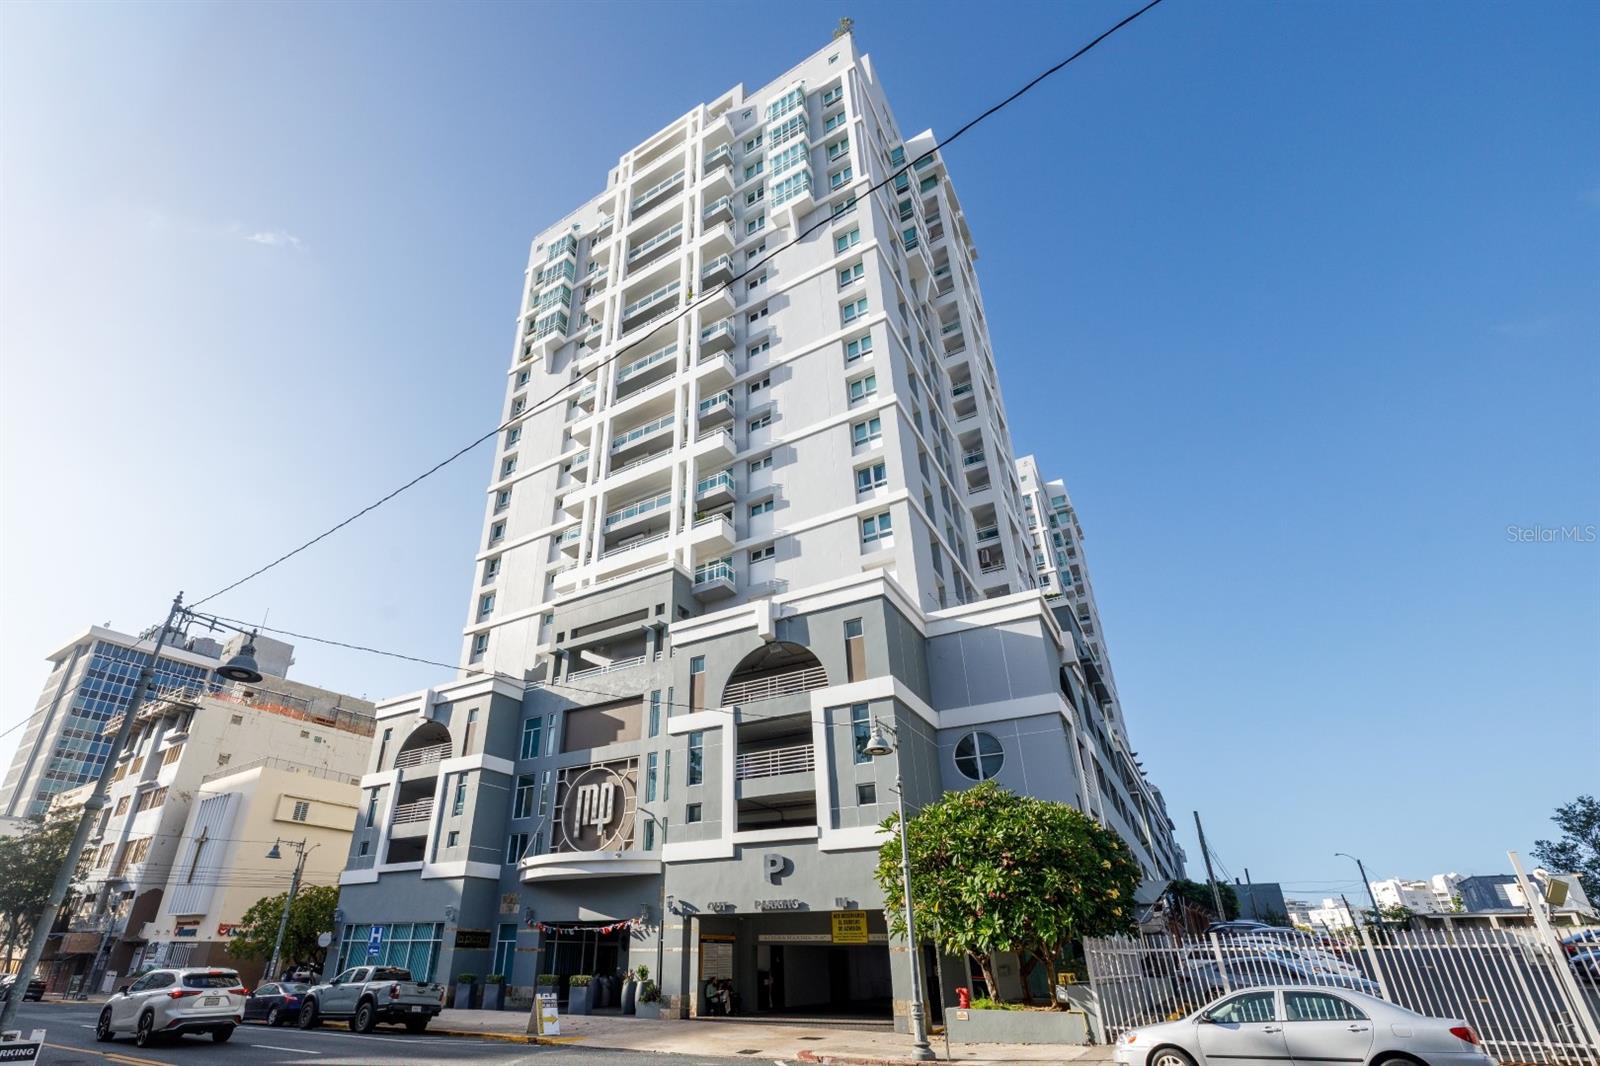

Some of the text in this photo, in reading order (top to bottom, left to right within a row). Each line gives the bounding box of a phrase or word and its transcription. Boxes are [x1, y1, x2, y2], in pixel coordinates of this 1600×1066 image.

[764, 854, 784, 882] P
[707, 901, 728, 912] OUT
[754, 899, 798, 909] PARKING
[370, 927, 383, 943] H
